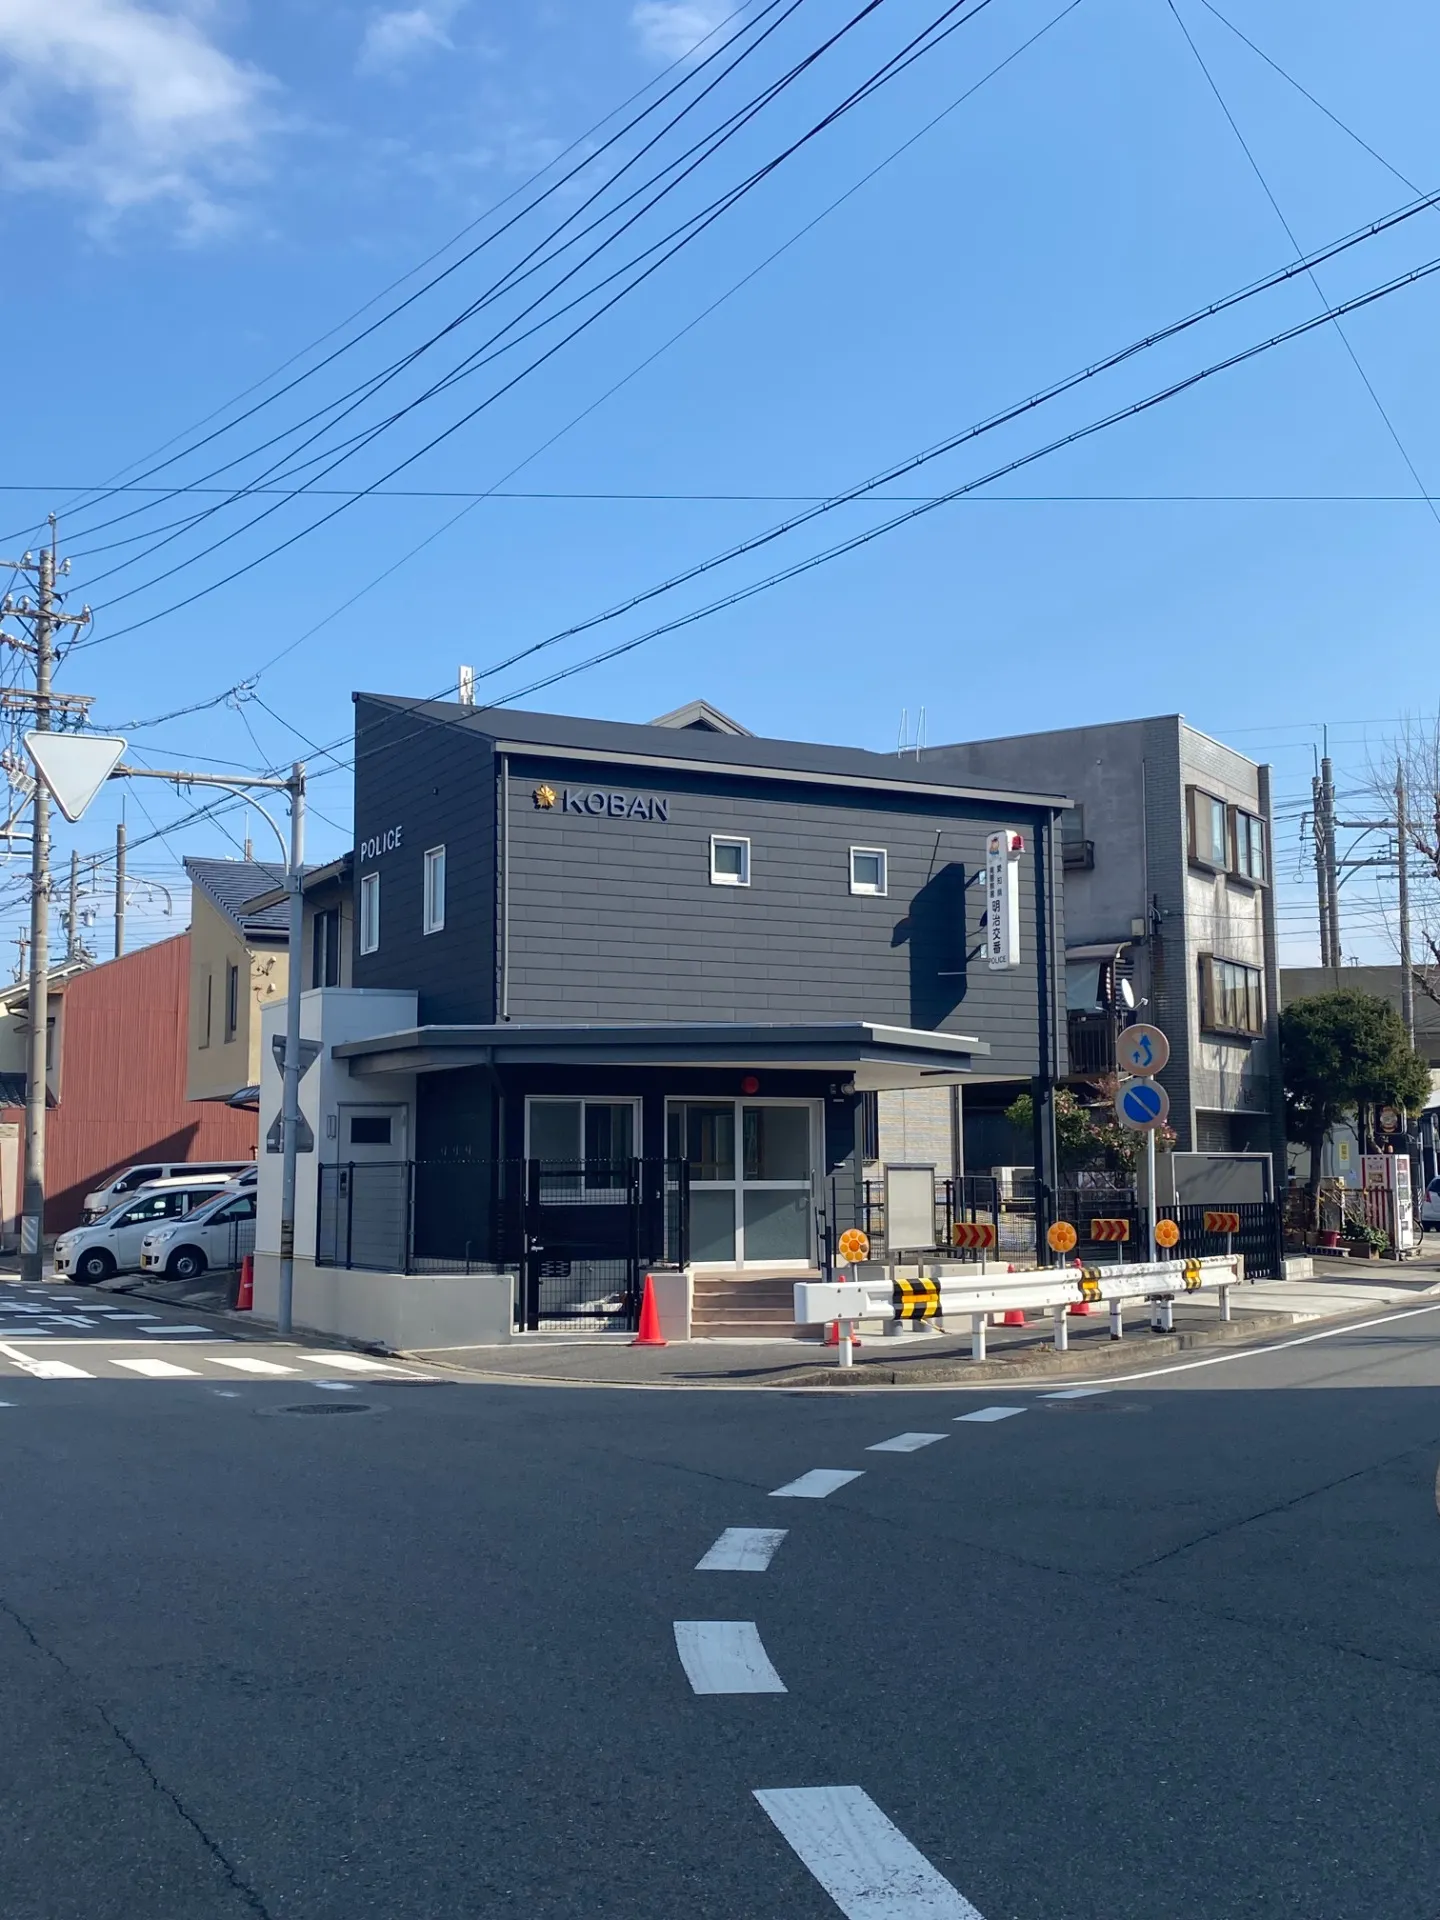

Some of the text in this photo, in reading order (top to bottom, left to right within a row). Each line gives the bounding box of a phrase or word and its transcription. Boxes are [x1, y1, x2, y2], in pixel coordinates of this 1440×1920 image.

[564, 788, 670, 821] KOBAN
[360, 825, 403, 863] POLICE
[991, 899, 1001, 954] 明治交番
